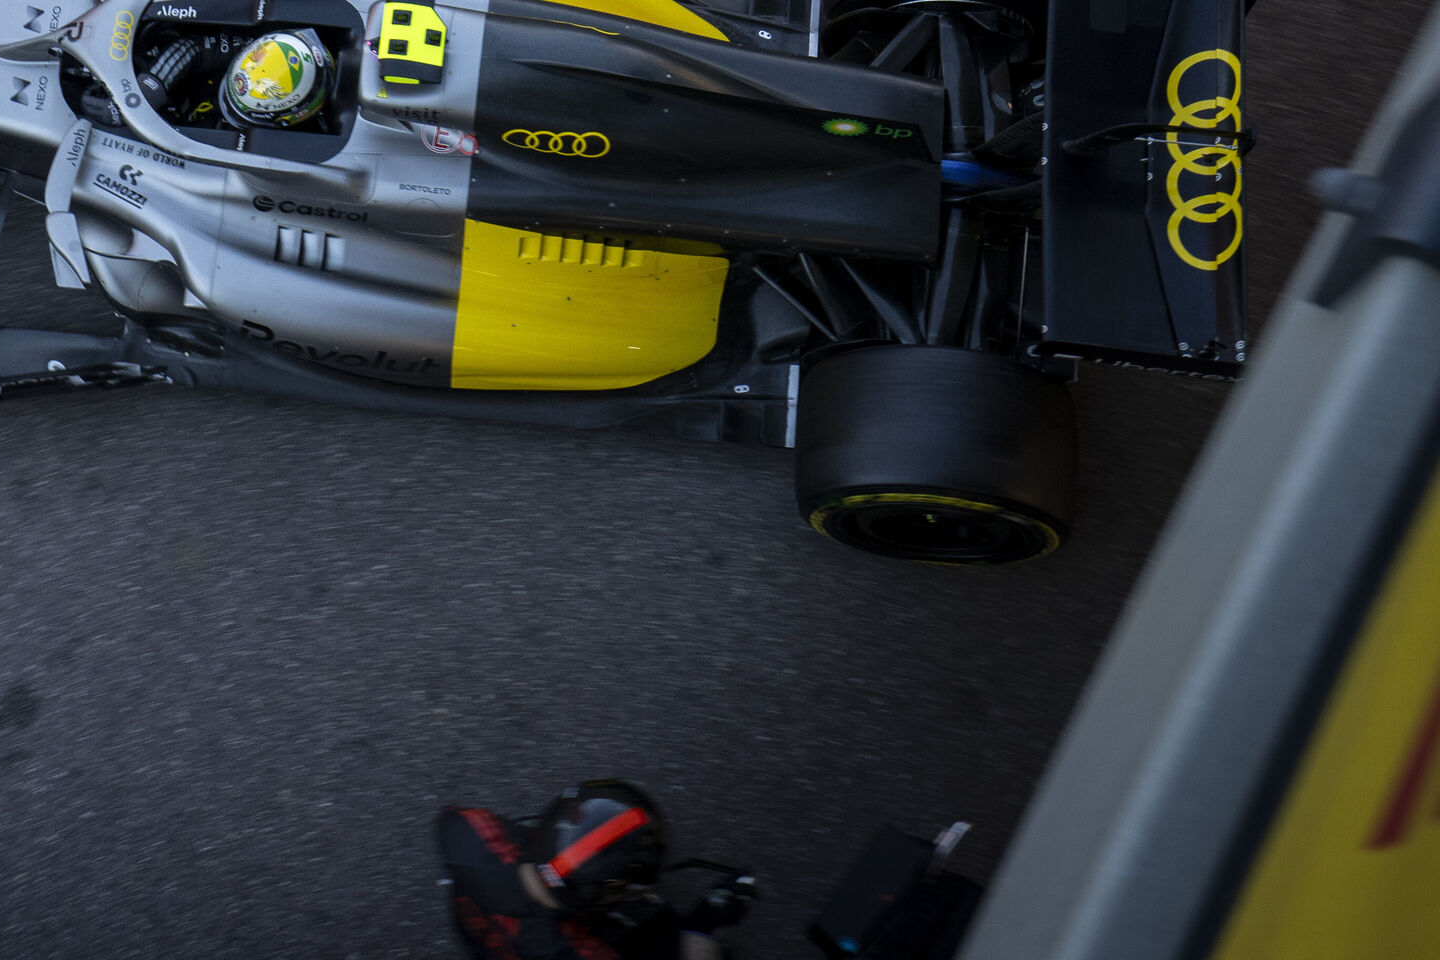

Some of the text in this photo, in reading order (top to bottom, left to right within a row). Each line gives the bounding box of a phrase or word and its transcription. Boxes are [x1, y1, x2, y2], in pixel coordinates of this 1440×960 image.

[49, 5, 62, 32] EXO
[157, 5, 197, 19] Aleph
[35, 75, 49, 111] NEXO
[874, 124, 913, 139] bp
[67, 128, 86, 167] Aleph
[101, 137, 186, 169] WORLD OF HYATT
[96, 173, 148, 206] CAMOZZI
[399, 183, 452, 196] BORTOLETO
[278, 200, 369, 223] Castrol
